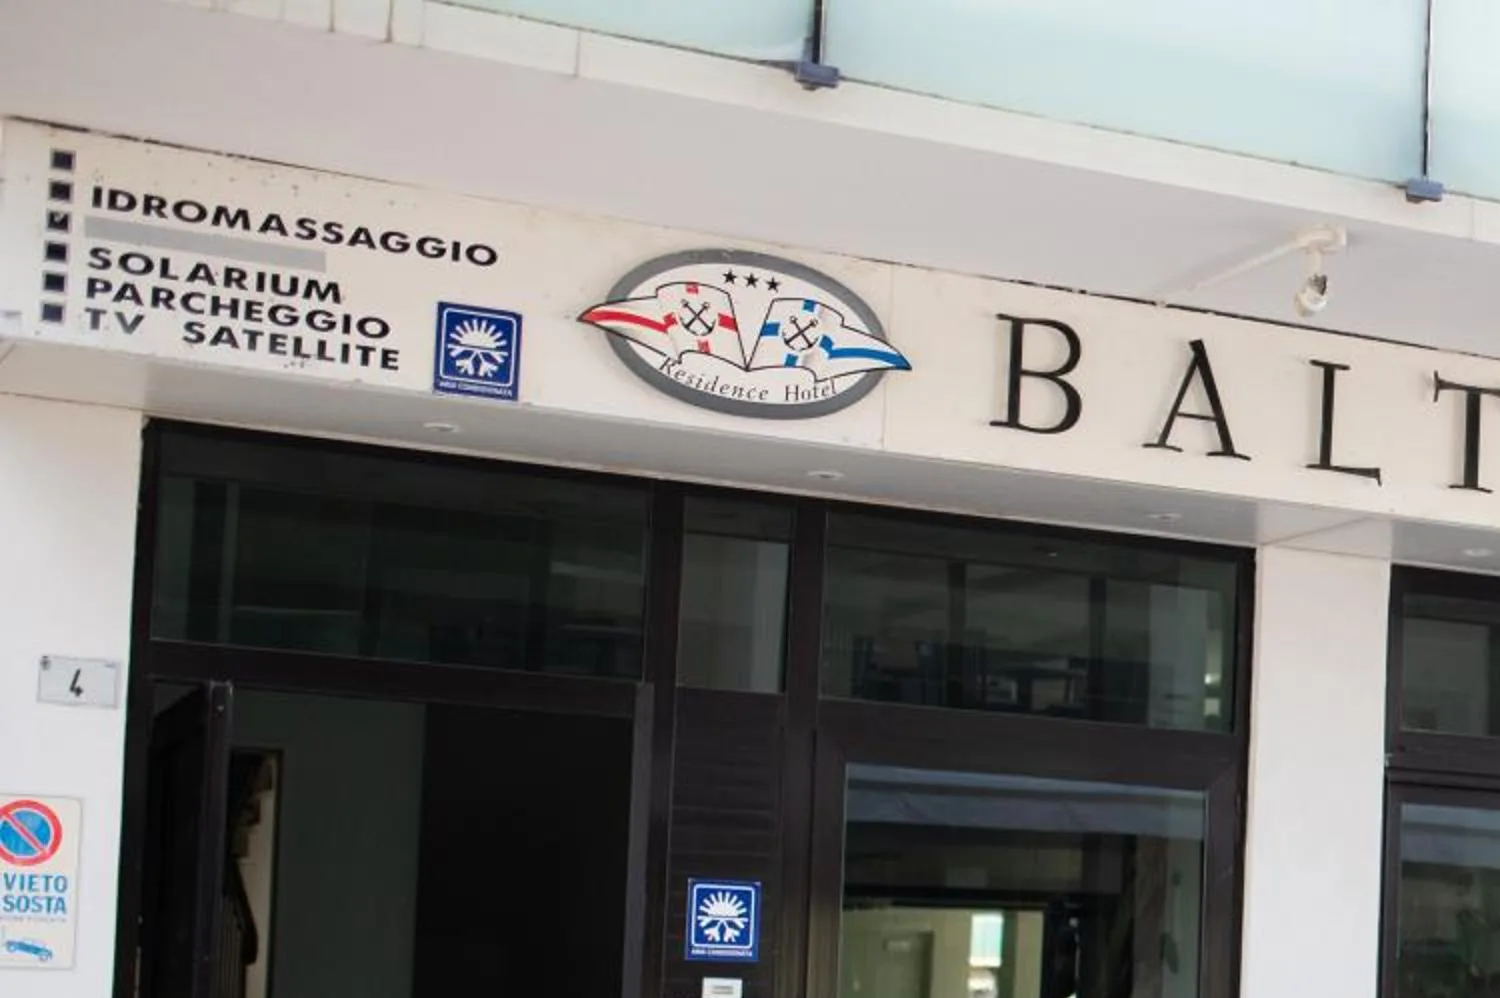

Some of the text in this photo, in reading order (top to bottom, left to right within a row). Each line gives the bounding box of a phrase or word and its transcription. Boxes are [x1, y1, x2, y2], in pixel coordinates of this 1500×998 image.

[91, 186, 499, 267] IDROMASSAGGIO
[87, 247, 343, 305] SOLARIUM
[85, 277, 391, 339] PARCHEGGIO
[84, 307, 400, 372] TV SATELLITE
[659, 355, 838, 402] Residence Hotel
[69, 667, 84, 698] 4
[2, 895, 67, 915] SOSTA
